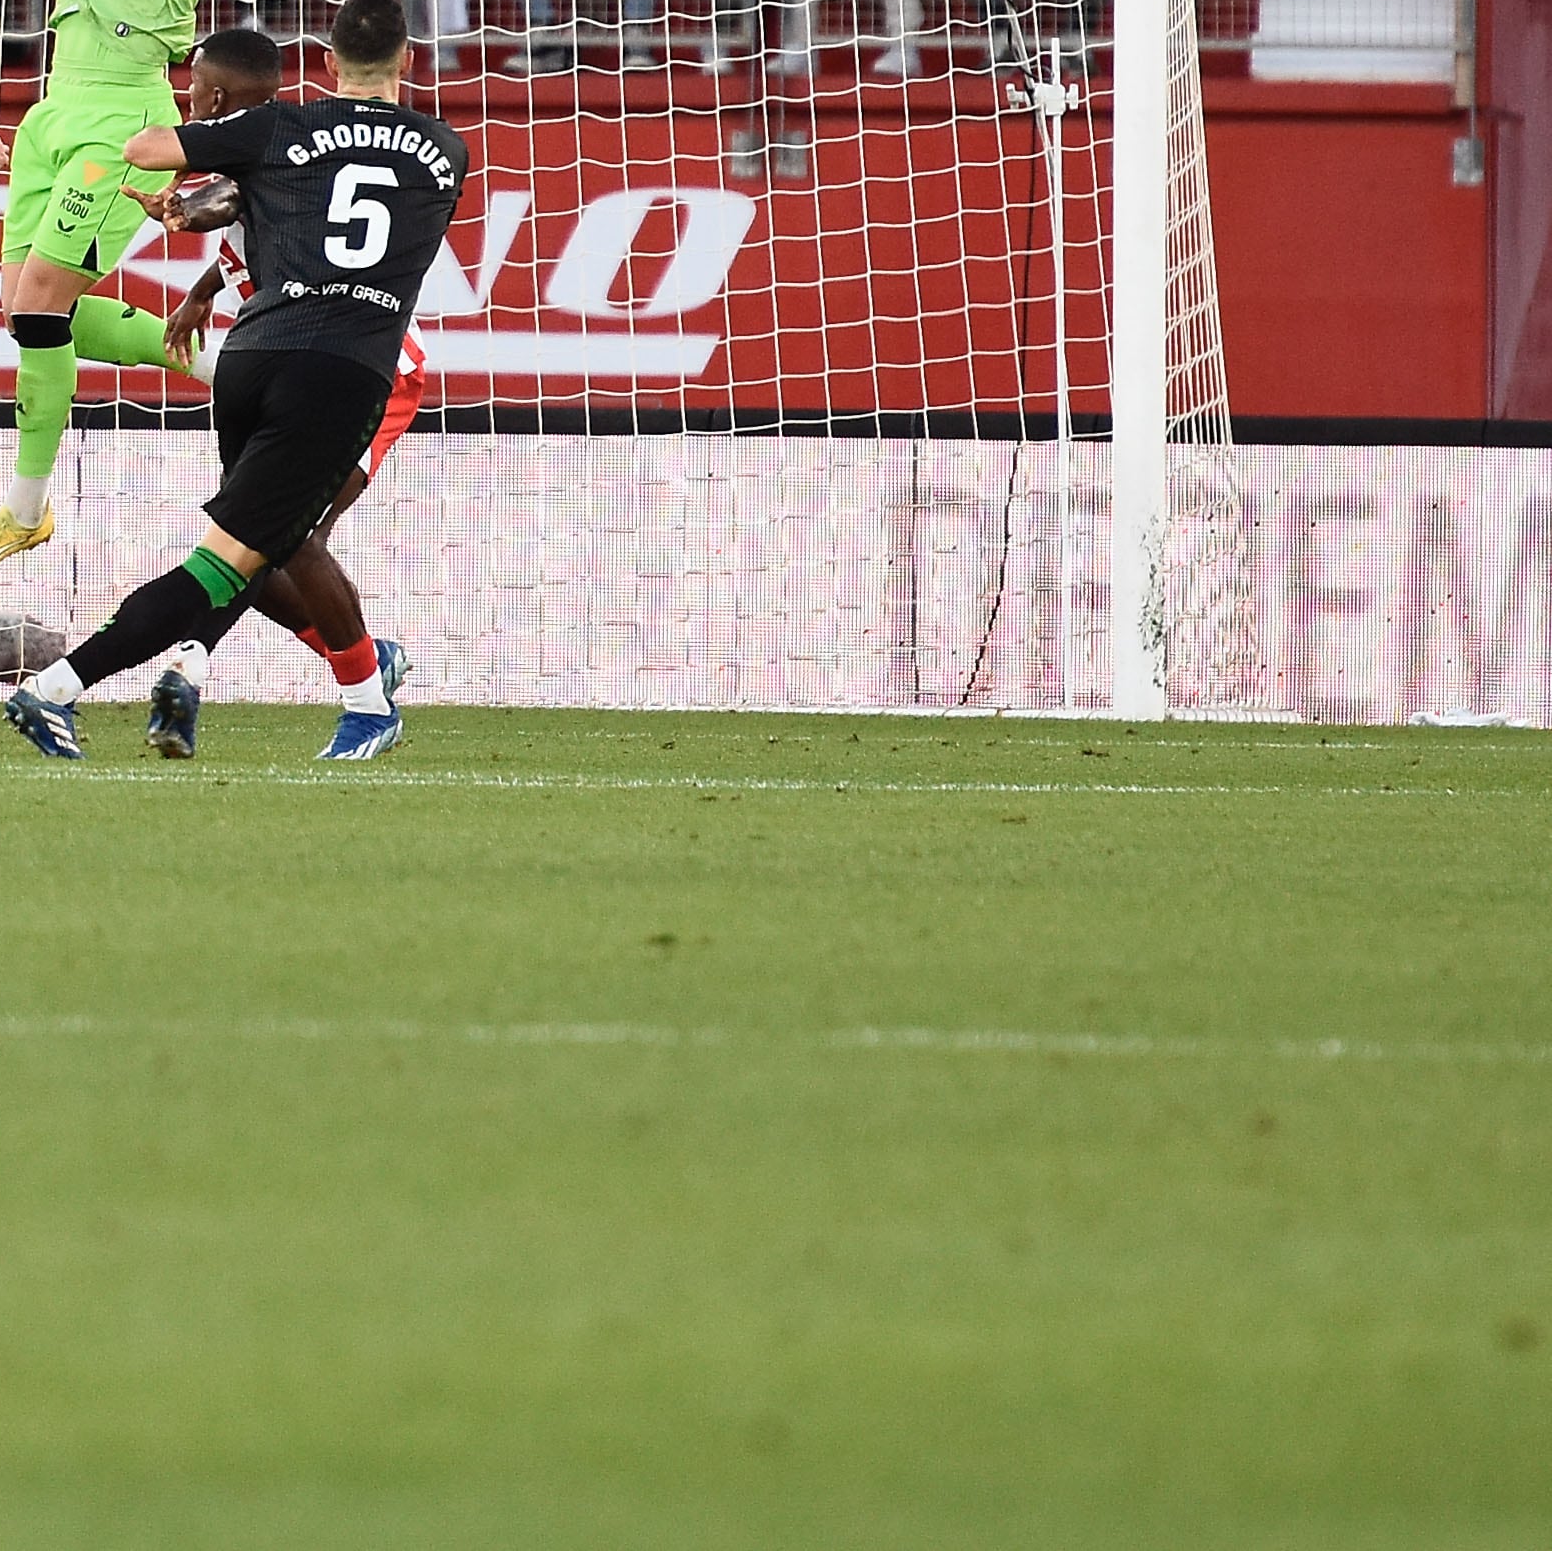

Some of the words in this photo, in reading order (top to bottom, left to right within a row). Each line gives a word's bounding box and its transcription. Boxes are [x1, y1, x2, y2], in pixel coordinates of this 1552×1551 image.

[286, 123, 456, 191] G.RODRÍGUEZ
[59, 197, 90, 220] KUDU
[323, 162, 400, 270] 5
[351, 284, 402, 314] GREEN
